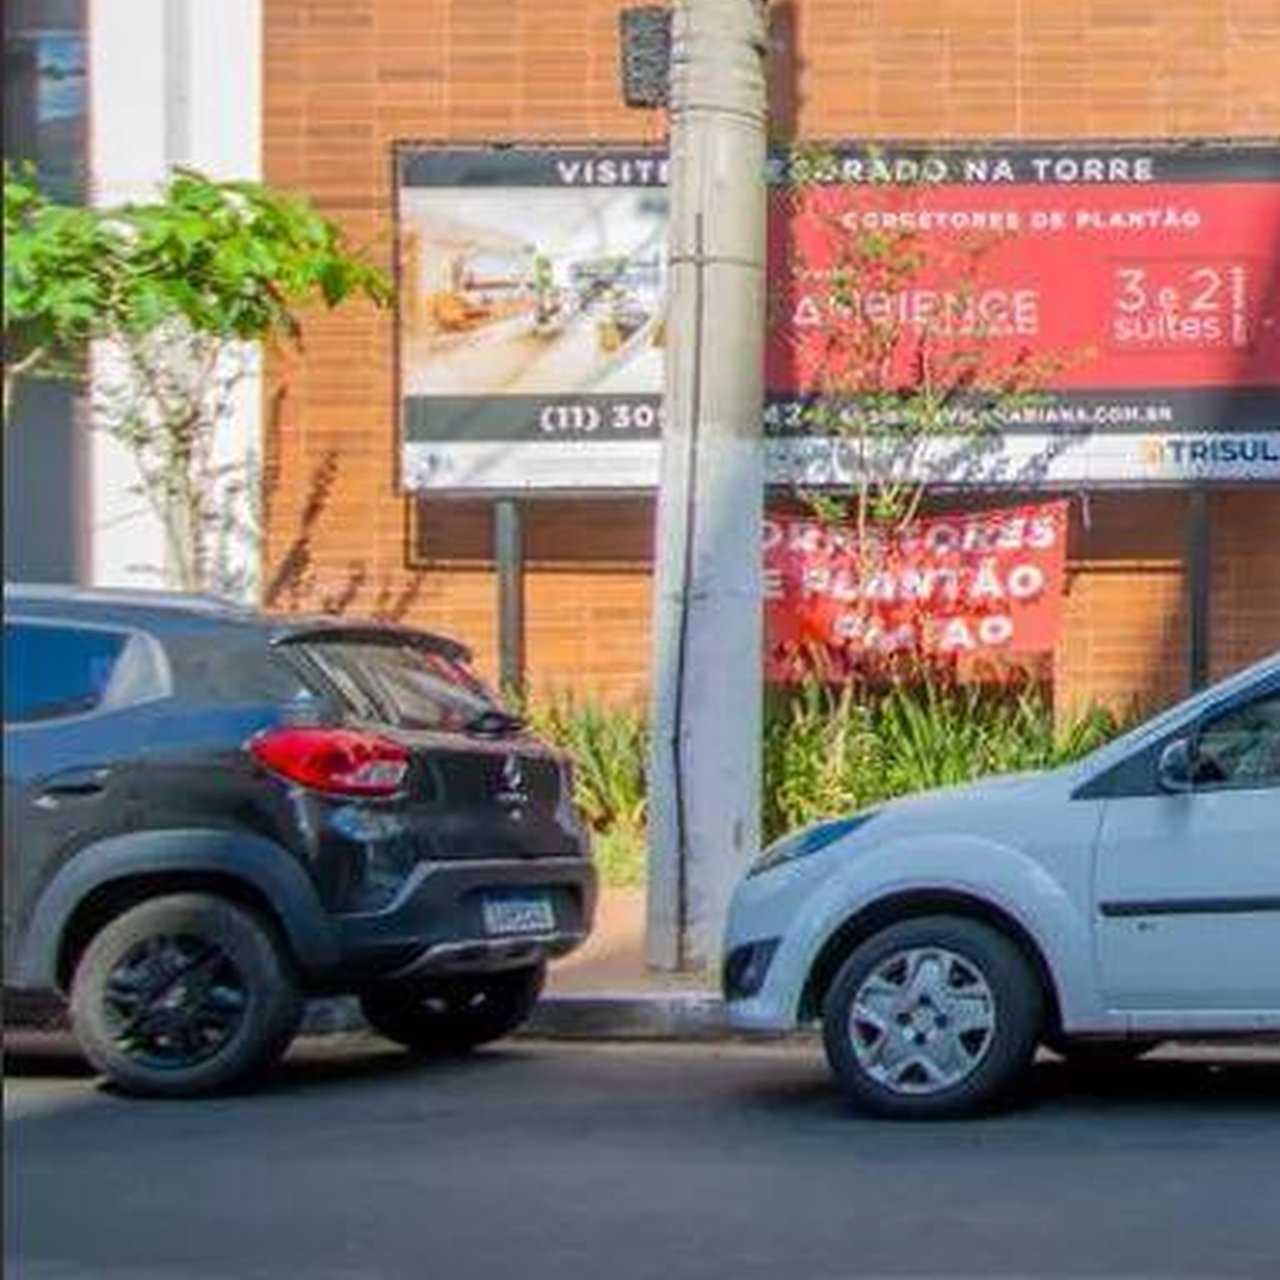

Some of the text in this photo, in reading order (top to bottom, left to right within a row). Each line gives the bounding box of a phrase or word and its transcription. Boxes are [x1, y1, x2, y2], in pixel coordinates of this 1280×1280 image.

[965, 158, 1015, 182] NA
[1031, 158, 1155, 182] TORRE
[1116, 268, 1147, 312] 3
[1187, 268, 1222, 311] 2
[540, 403, 600, 432] (11)
[1166, 438, 1280, 463] TRISUL
